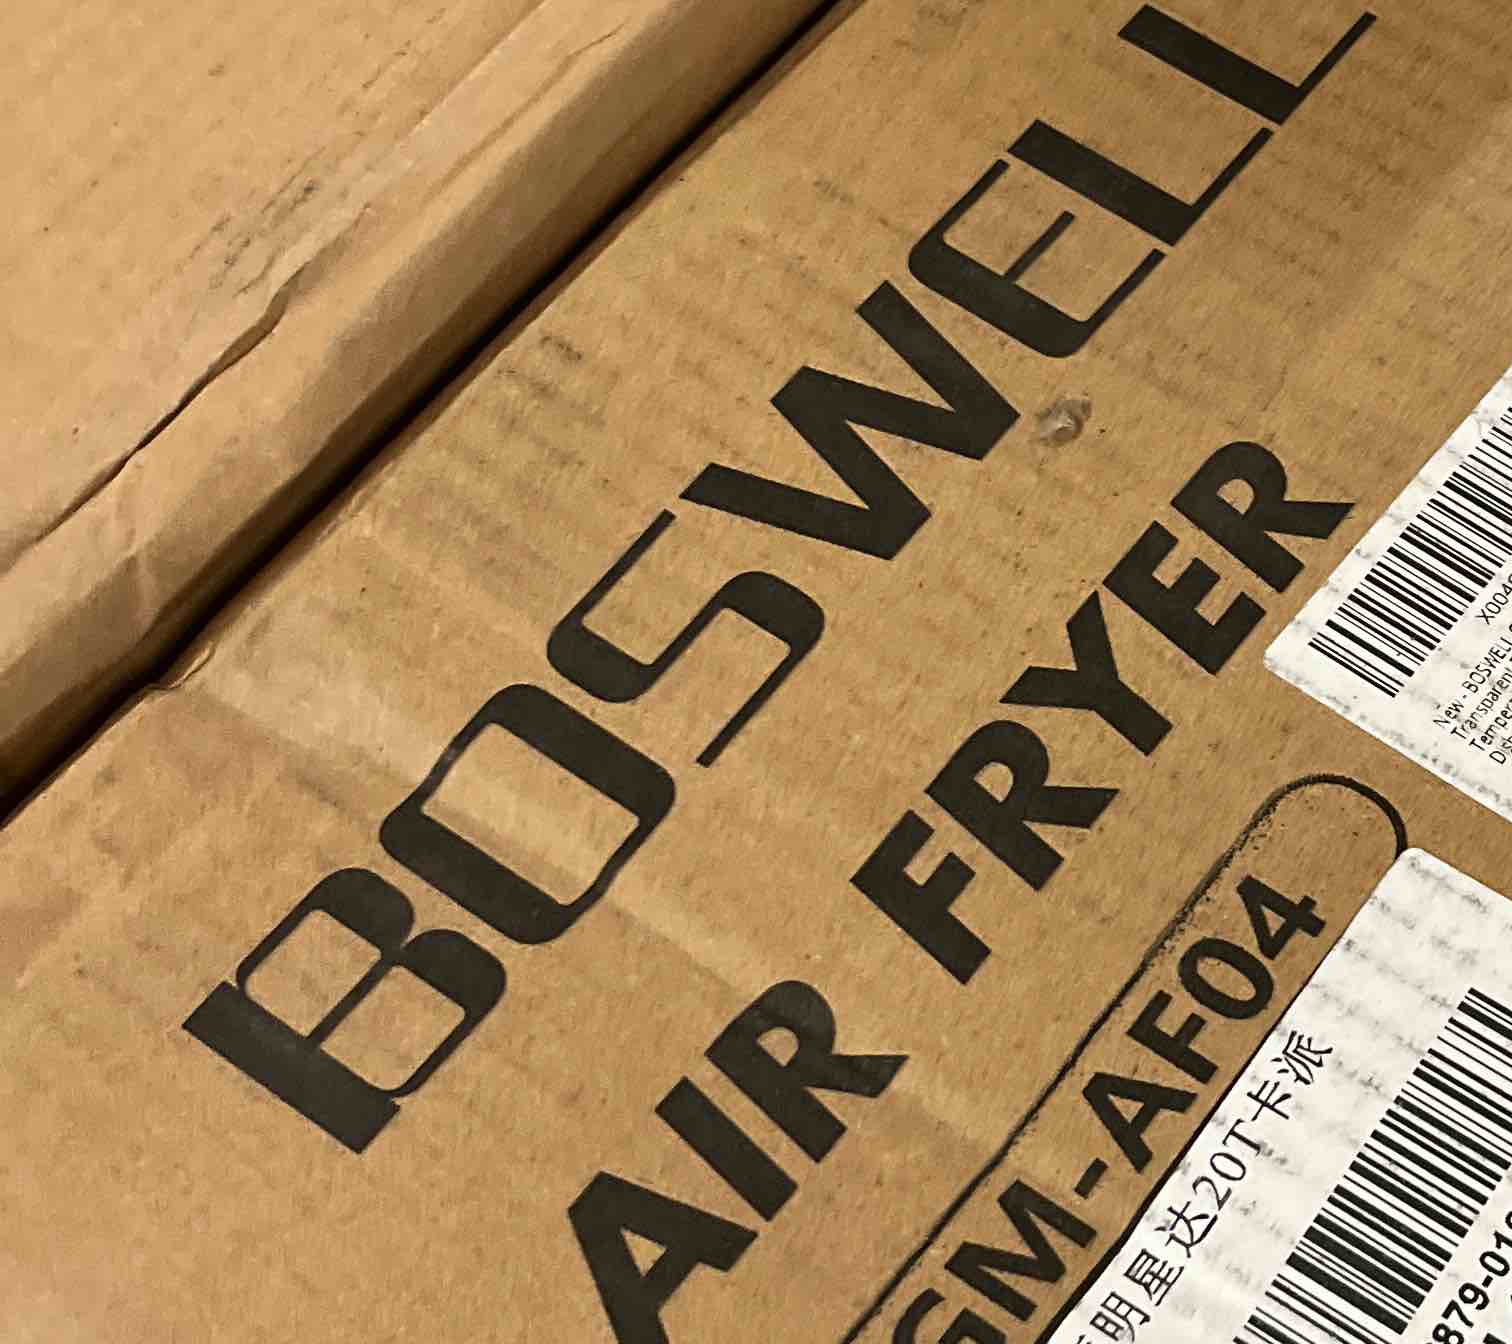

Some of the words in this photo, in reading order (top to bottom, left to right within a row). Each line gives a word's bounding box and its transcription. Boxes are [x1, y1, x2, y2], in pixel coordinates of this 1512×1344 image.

[182, 3, 1375, 1152] BOSWELL
[850, 440, 1353, 983] FRYER
[1432, 699, 1466, 729] New
